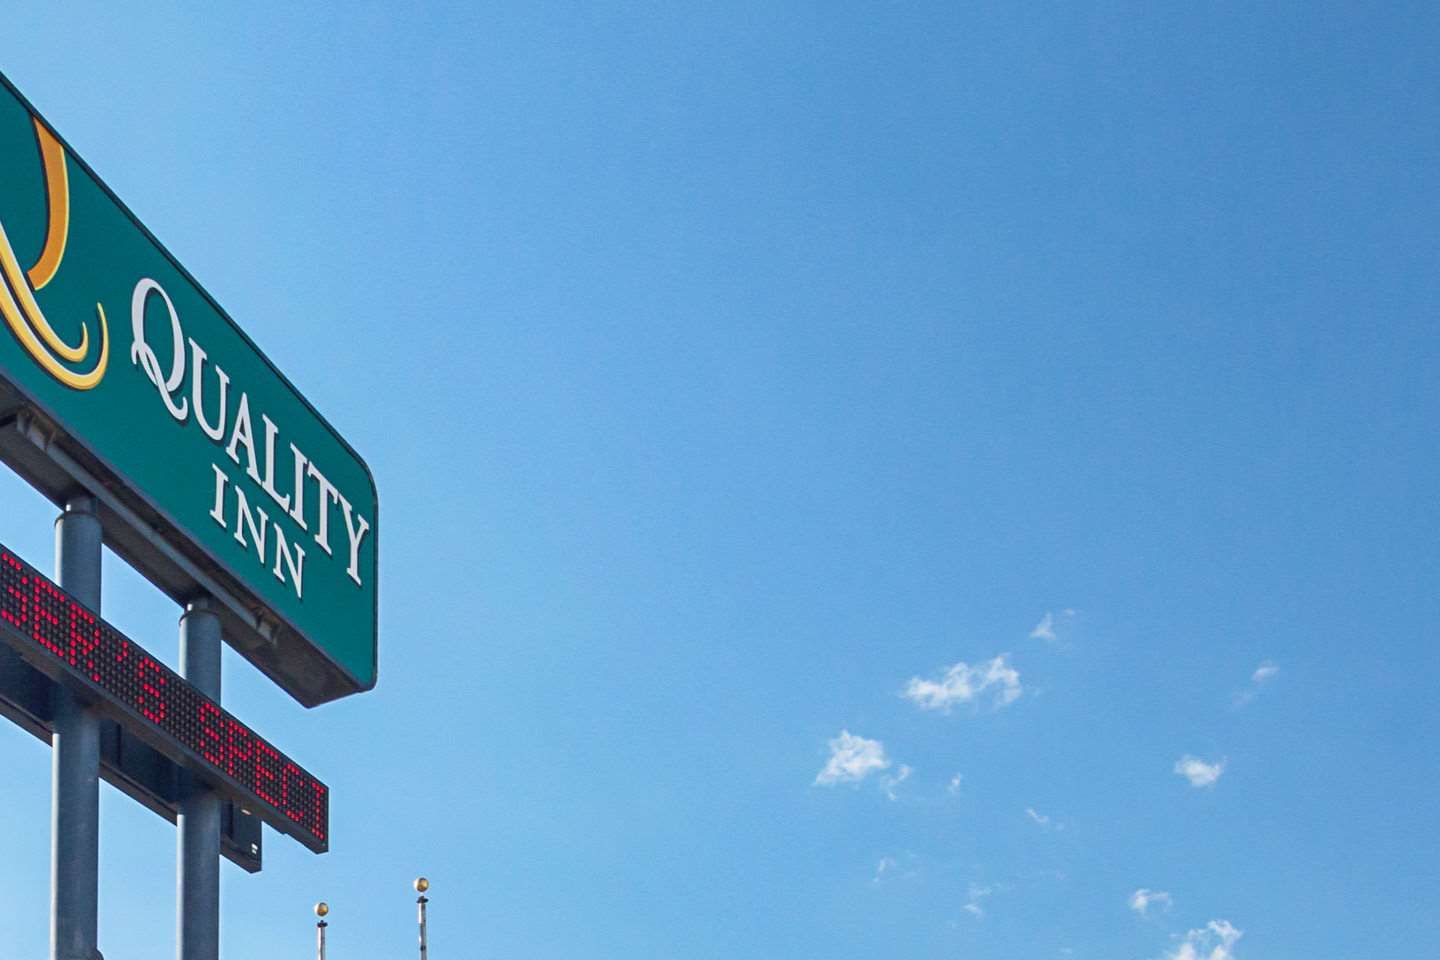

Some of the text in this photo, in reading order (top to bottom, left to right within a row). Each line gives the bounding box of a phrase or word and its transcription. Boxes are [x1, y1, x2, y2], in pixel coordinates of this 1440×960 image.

[130, 277, 369, 586] QUALITY
[210, 464, 306, 599] INN
[199, 702, 326, 841] SPECI
